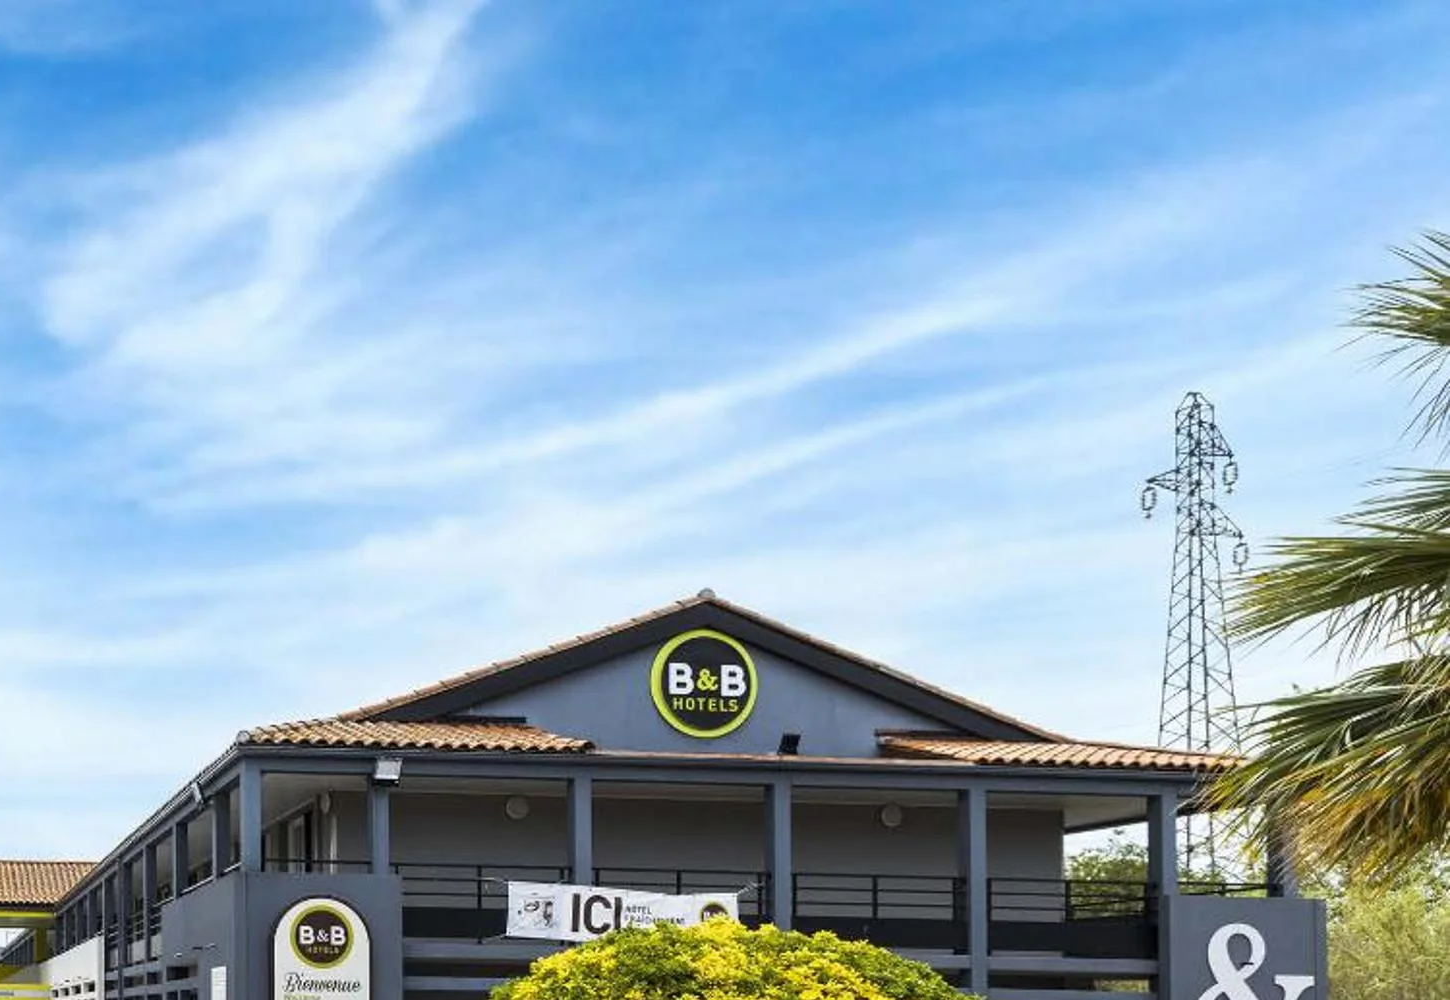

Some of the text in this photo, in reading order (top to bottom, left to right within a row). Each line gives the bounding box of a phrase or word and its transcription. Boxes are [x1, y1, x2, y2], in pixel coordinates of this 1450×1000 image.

[668, 662, 746, 697] B&B
[673, 697, 738, 712] HOTELS
[571, 892, 623, 935] ICI
[298, 925, 346, 946] B&B
[282, 972, 362, 993] Bienvenue
